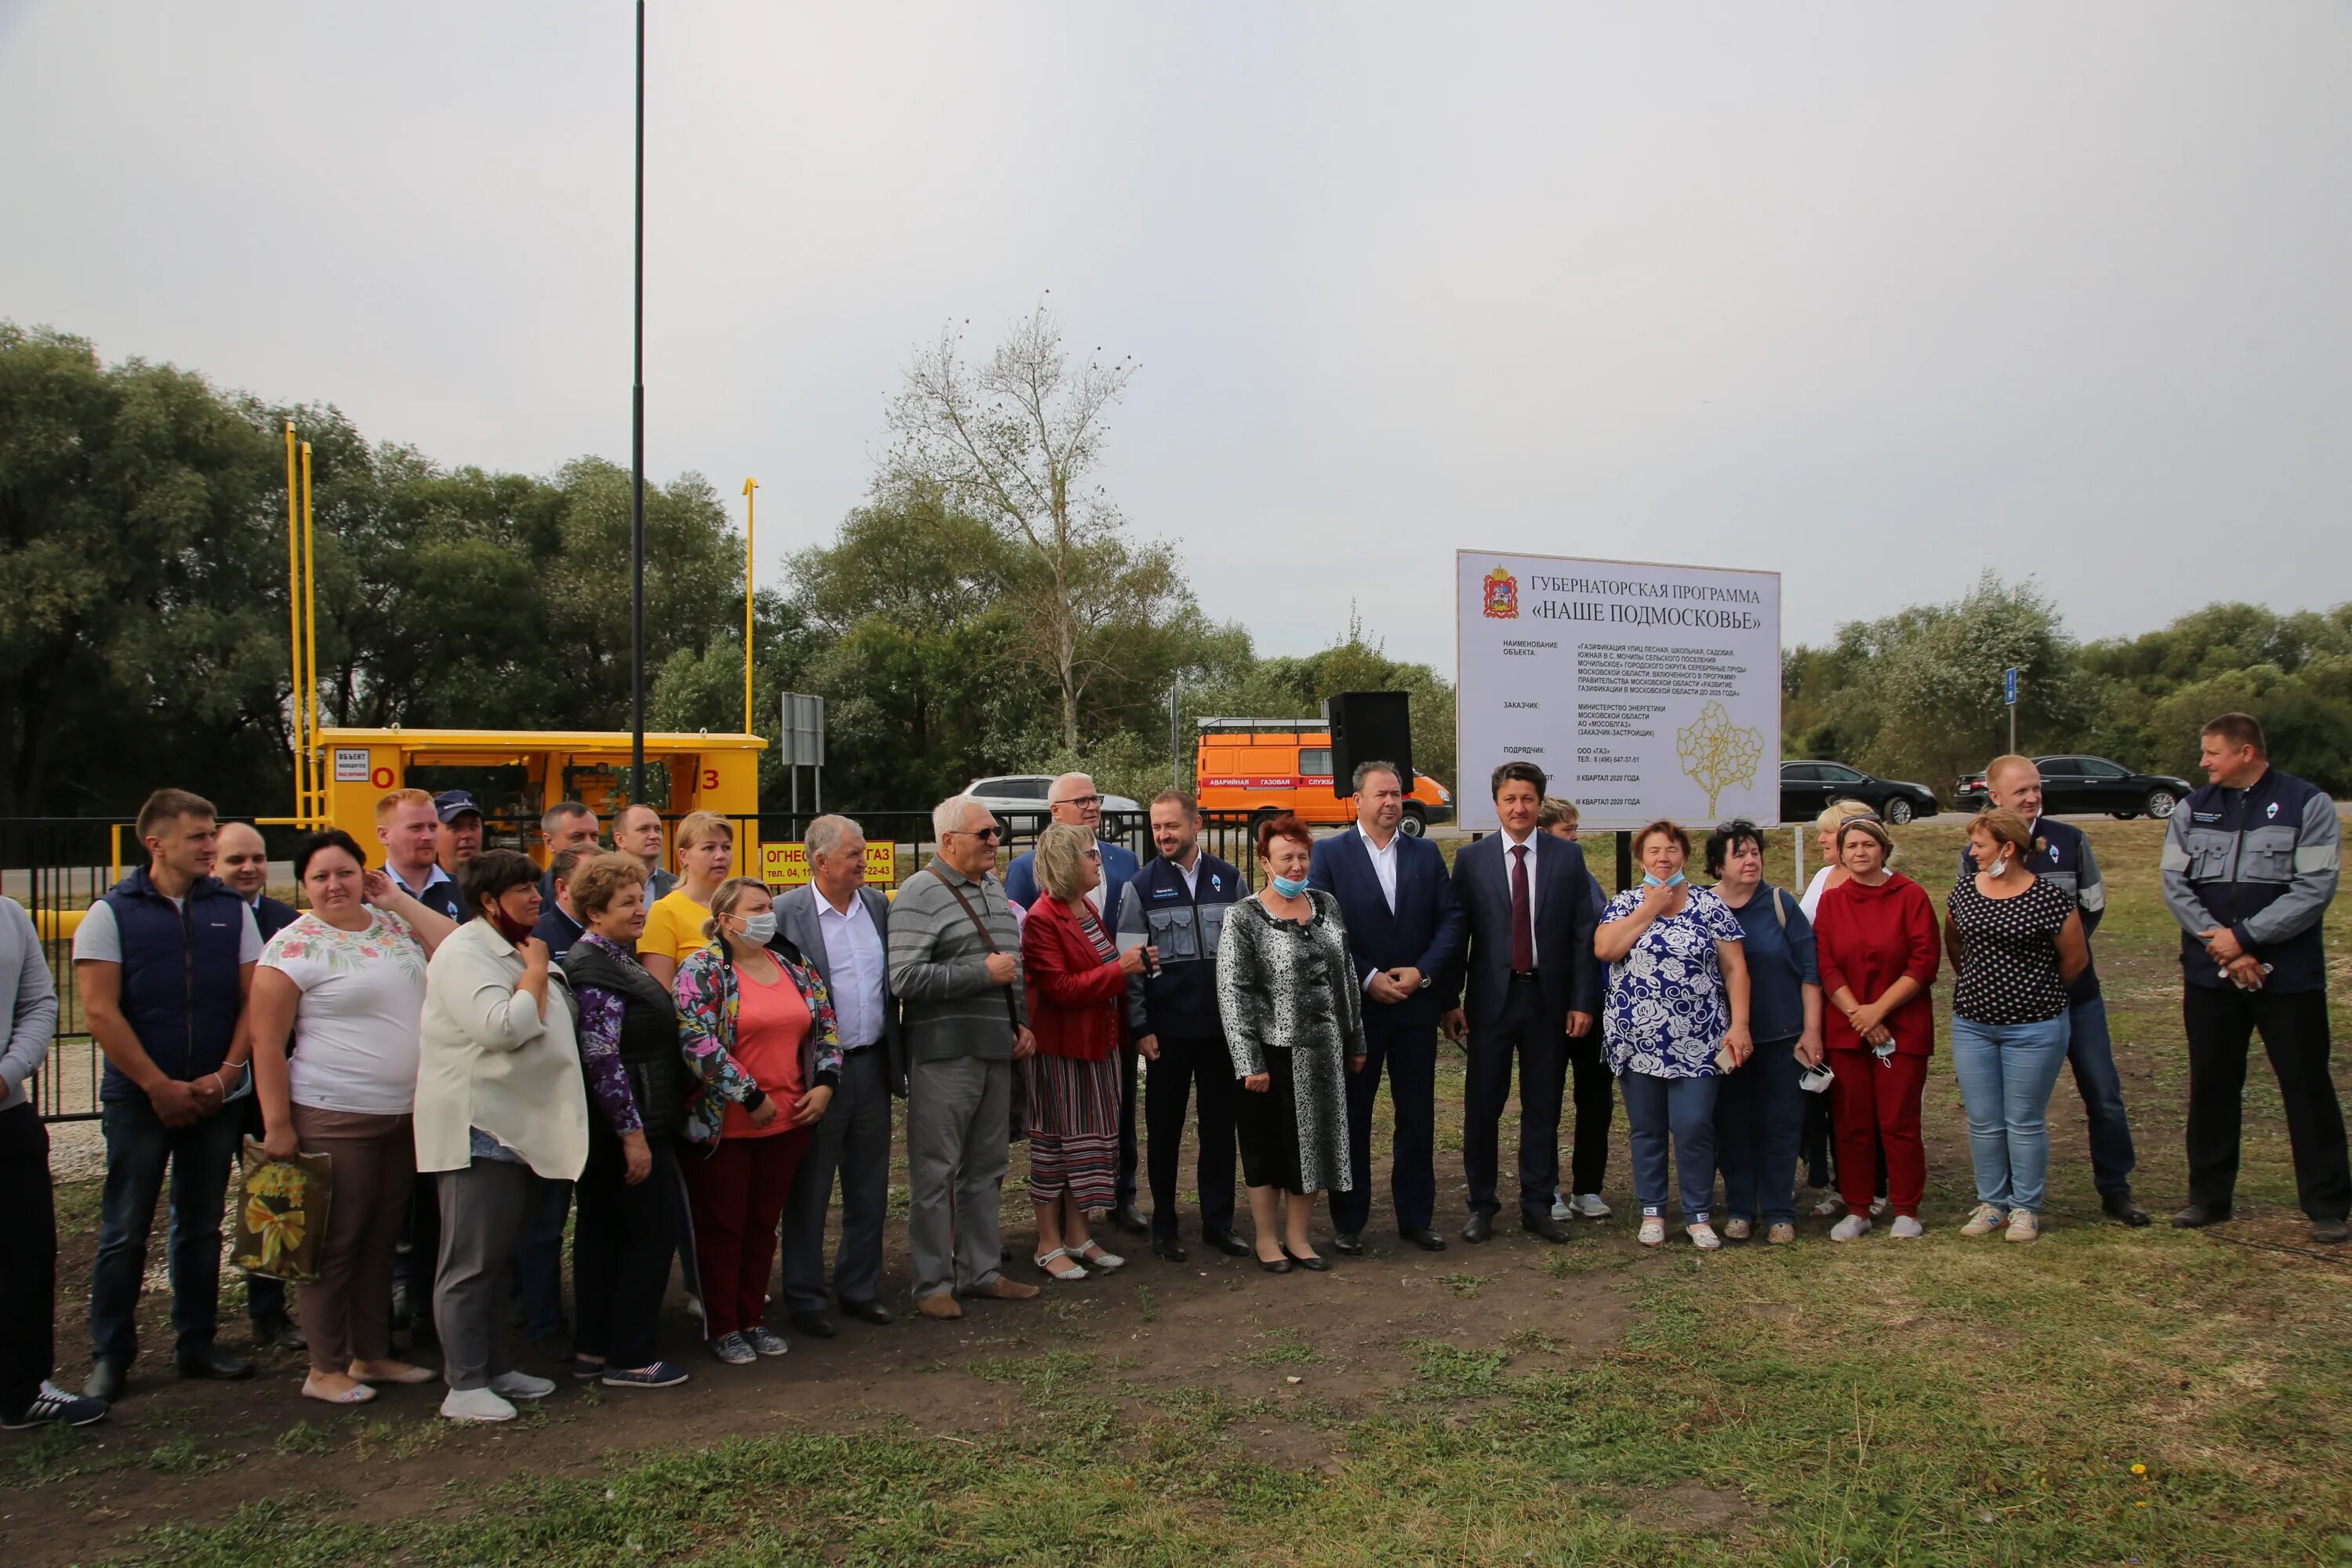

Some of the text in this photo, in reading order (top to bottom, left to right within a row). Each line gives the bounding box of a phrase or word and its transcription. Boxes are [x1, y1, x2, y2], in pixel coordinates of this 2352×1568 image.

[1531, 575, 1760, 604] ГУБЕРНАТОРСКАЯ ПРОГРАММА
[1532, 601, 1761, 630] «НАШЕ ПОДМОСКОВЬЕ»
[1503, 640, 1558, 648] НАИМЕНОВАНИЕ
[1578, 729, 1655, 738] (ЗАКАЗЧИК-ЗАСТРОЙЩИК)
[866, 848, 889, 860] ГАЗ
[787, 869, 799, 878] 04,
[863, 866, 889, 875] -22-43
